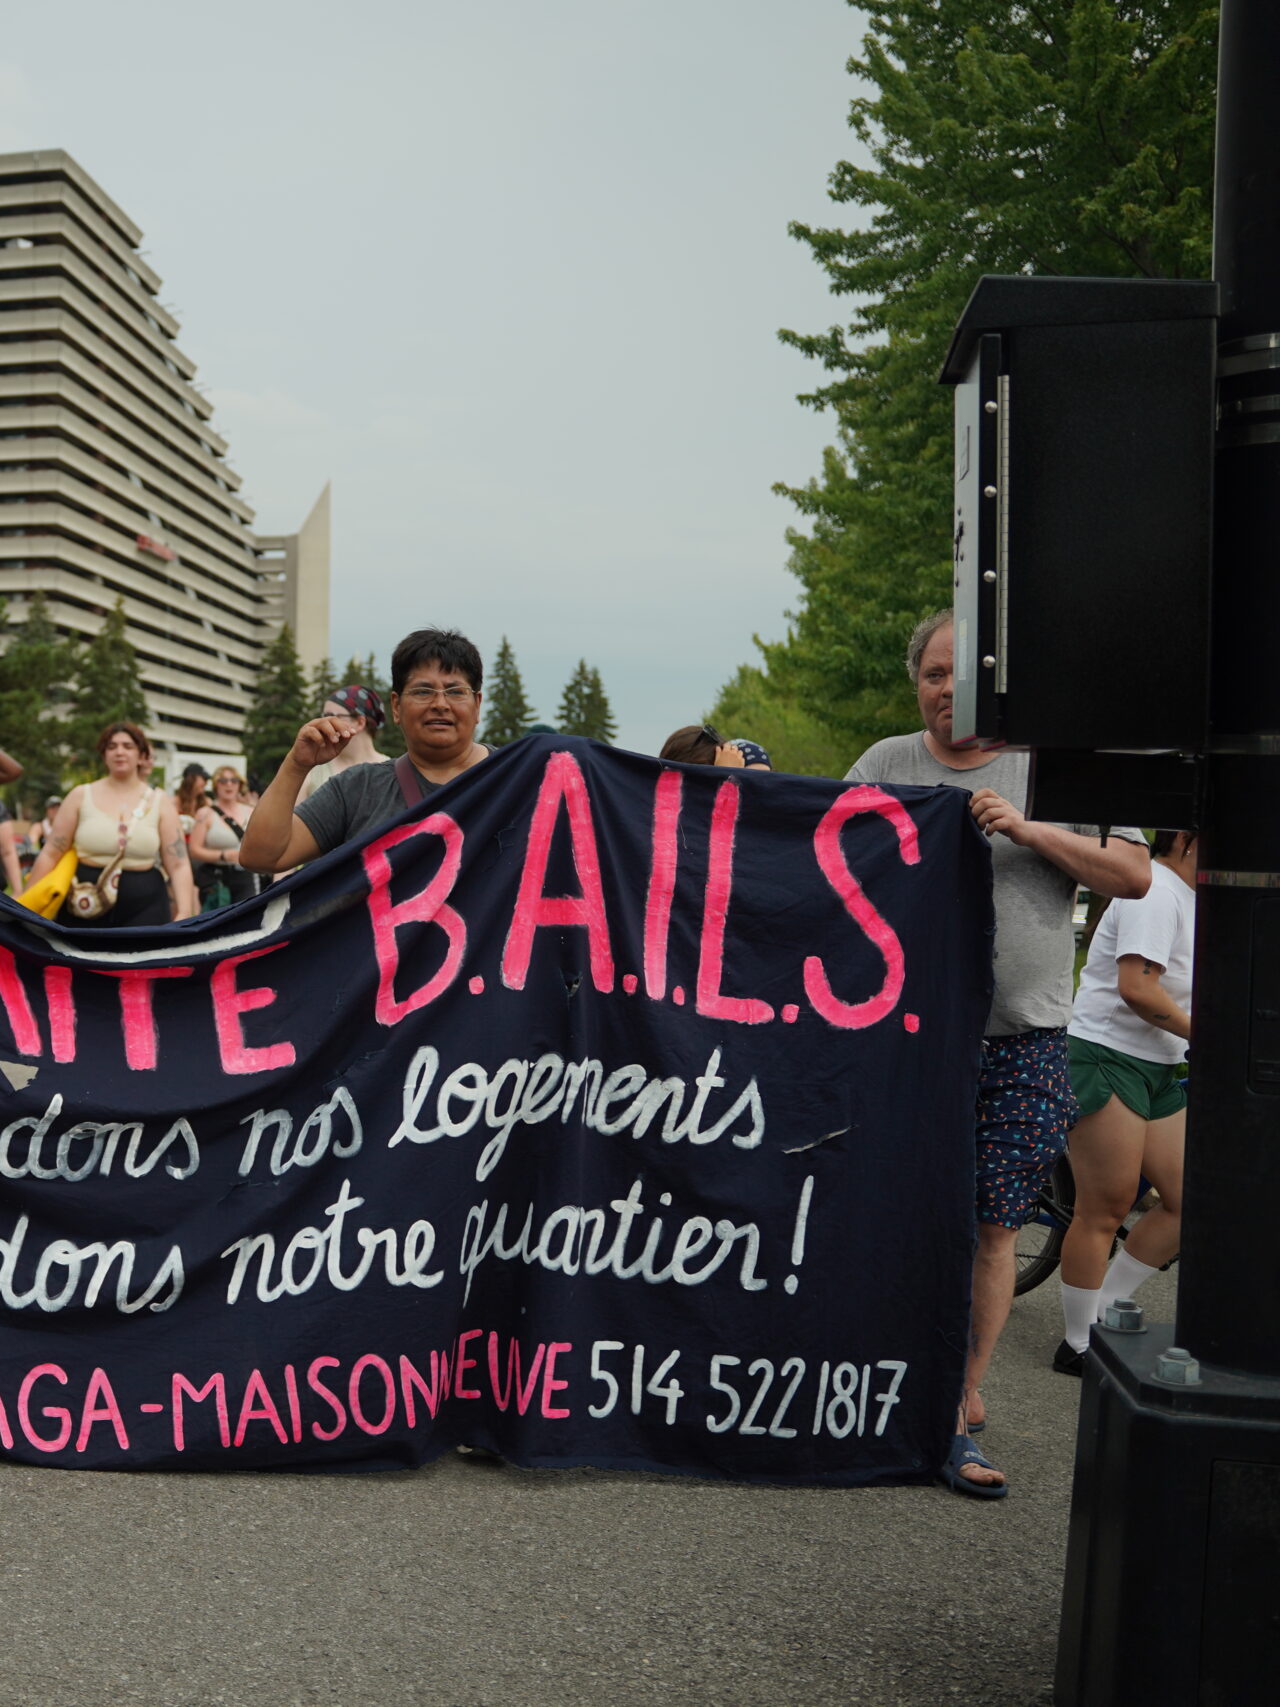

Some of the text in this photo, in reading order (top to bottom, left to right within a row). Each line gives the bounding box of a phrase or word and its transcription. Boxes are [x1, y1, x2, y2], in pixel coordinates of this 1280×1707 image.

[362, 751, 921, 1034] B.A.I.L.S.
[236, 1086, 362, 1178] nos
[388, 1044, 766, 1182] logements
[221, 1177, 444, 1305] notre
[587, 1339, 685, 1427] 514
[706, 1355, 806, 1438] 522
[812, 1359, 908, 1439] 1817
